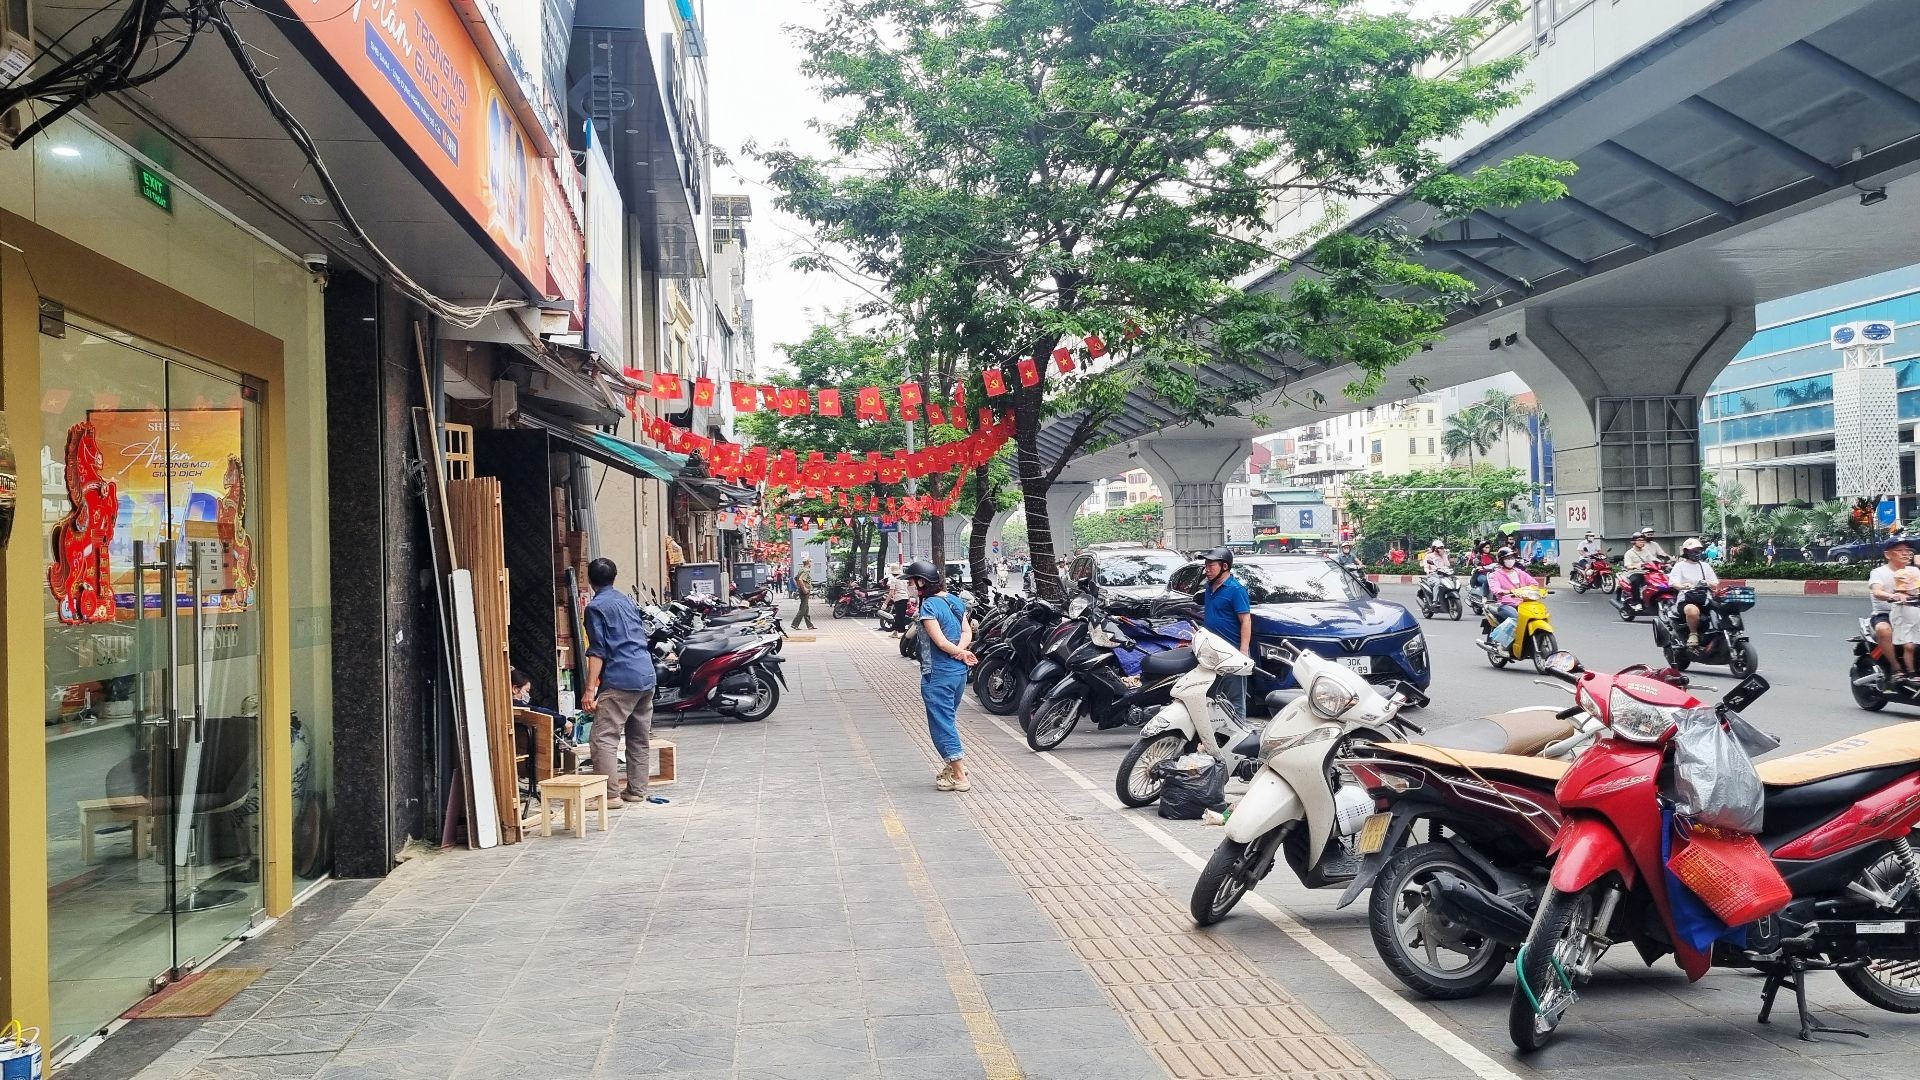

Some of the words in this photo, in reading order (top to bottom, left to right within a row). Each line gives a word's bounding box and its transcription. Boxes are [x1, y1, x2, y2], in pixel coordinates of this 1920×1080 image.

[414, 8, 449, 80] TRONG
[414, 48, 439, 99] GIAO
[441, 85, 461, 130] DỊCH
[143, 171, 162, 194] EXIT
[1568, 506, 1587, 521] P38
[1347, 658, 1361, 667] 30K
